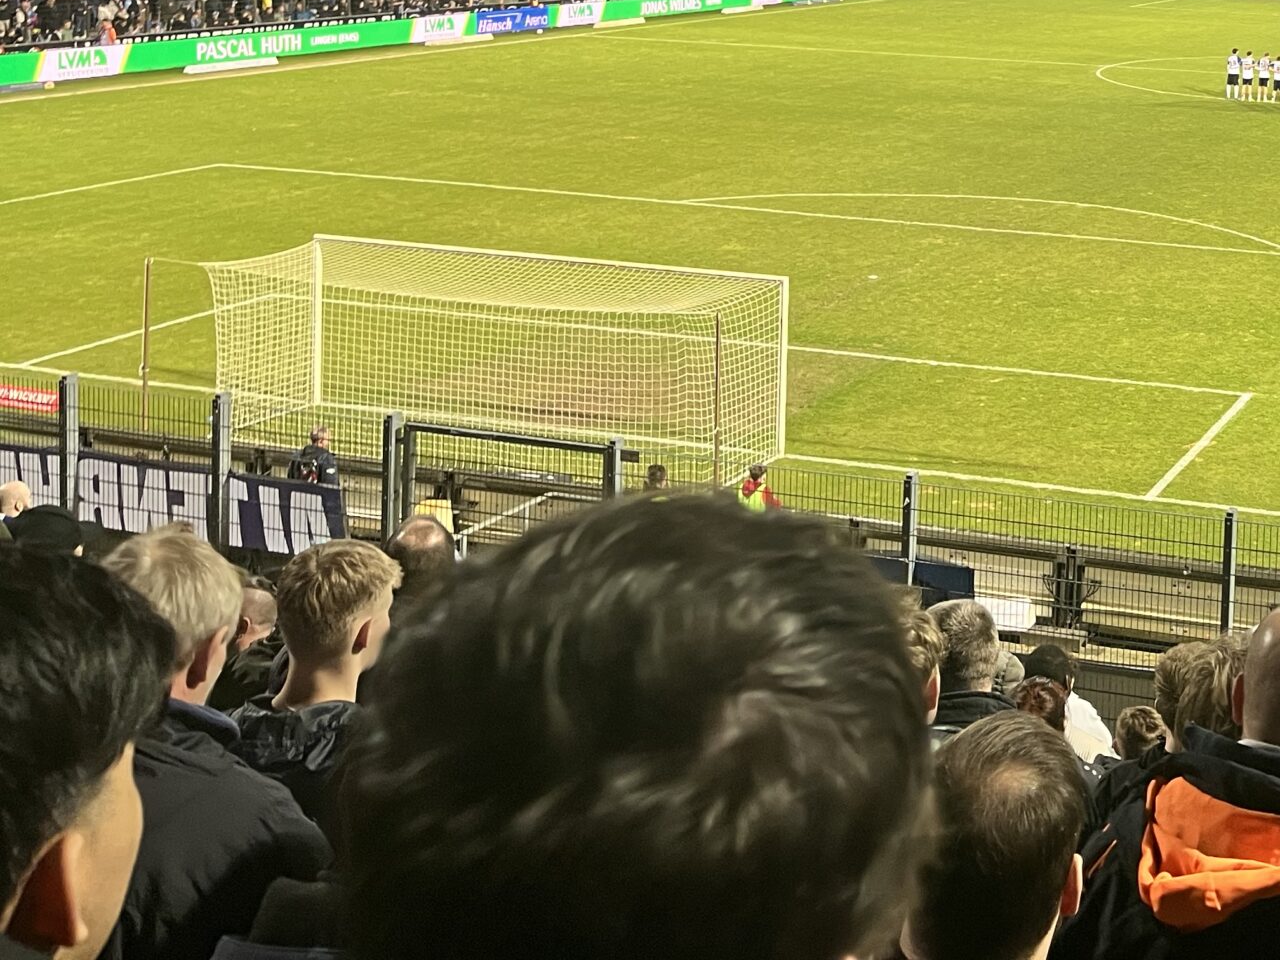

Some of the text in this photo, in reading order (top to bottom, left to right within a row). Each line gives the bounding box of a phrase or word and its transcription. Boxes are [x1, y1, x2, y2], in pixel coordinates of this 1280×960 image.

[568, 4, 586, 18] LVM
[641, 0, 669, 16] JONAS
[424, 19, 446, 33] LVM
[477, 14, 548, 34] Hänsch Arena
[196, 38, 257, 61] PASCAL
[261, 33, 303, 55] HUTH
[58, 49, 92, 70] LVM
